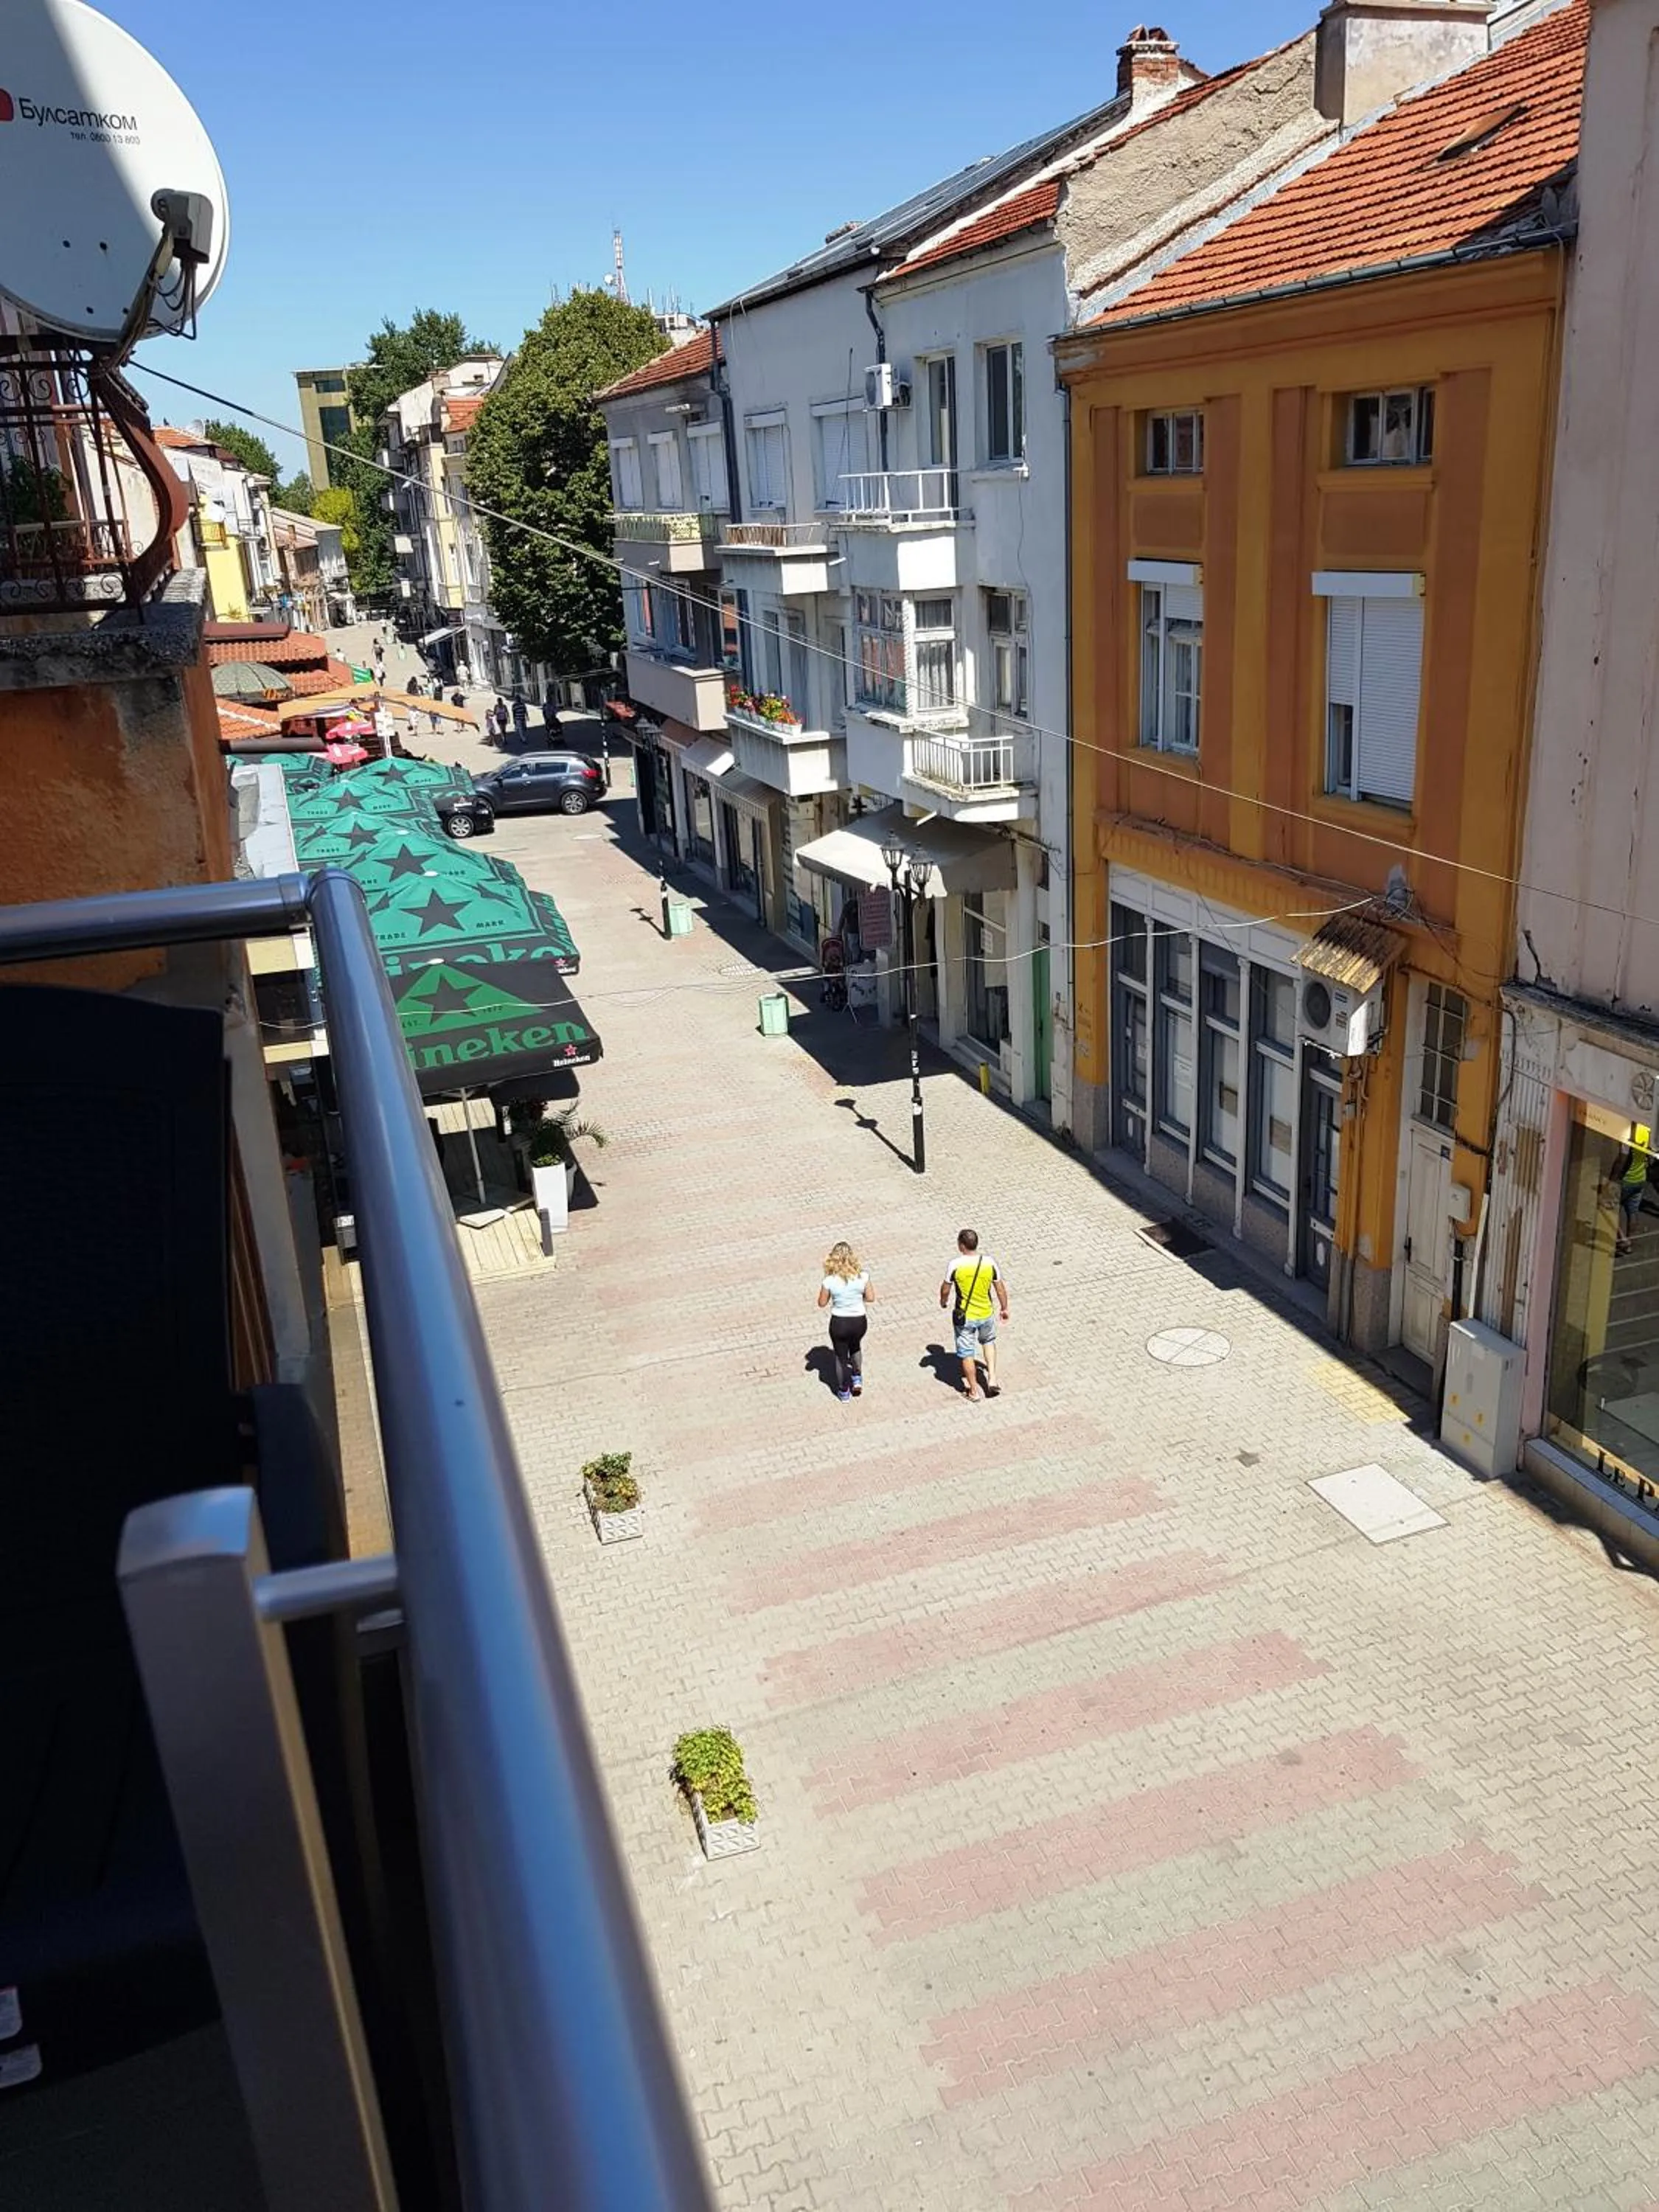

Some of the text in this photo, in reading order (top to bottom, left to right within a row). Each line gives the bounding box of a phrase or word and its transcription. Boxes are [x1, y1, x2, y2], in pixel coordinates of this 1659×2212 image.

[18, 97, 138, 131] Булсатком
[406, 1021, 590, 1069] ineken
[1636, 1475, 1659, 1512] P
